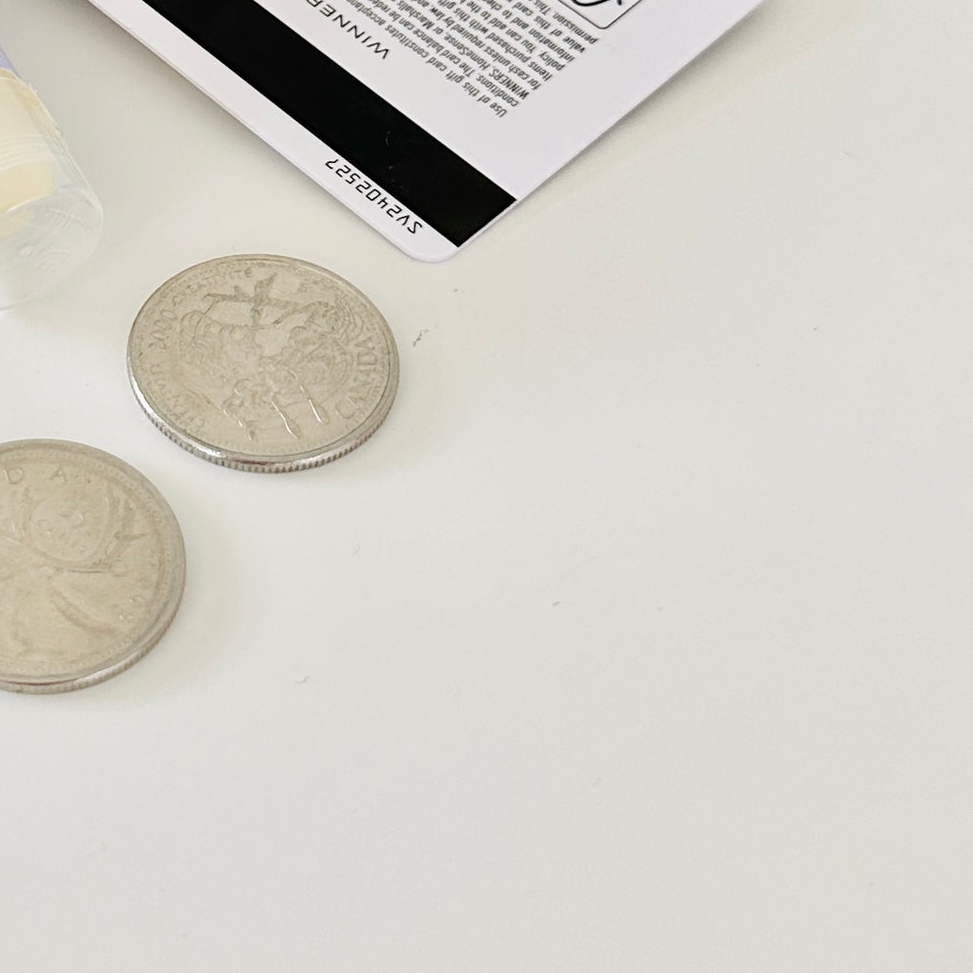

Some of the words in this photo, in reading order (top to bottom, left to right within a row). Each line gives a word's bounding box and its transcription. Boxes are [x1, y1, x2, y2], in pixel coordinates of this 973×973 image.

[451, 6, 471, 23] this
[465, 0, 482, 14] the
[478, 9, 492, 21] to
[500, 8, 513, 20] to
[510, 0, 535, 17] card
[387, 9, 402, 23] be
[397, 16, 416, 31] can
[441, 15, 456, 29] by
[486, 16, 508, 31] add
[508, 15, 530, 30] and
[532, 14, 552, 30] this
[431, 25, 444, 36] or
[467, 17, 490, 35] with
[503, 27, 523, 42] can
[547, 27, 564, 37] of
[383, 23, 430, 59] constitutes
[411, 27, 445, 54] balance
[448, 22, 486, 49] required
[483, 30, 532, 64] purchased
[519, 38, 537, 55] You
[527, 27, 576, 64] information
[561, 35, 586, 54] value
[424, 55, 448, 72] card
[437, 48, 462, 65] card
[481, 44, 512, 67] unless
[443, 69, 466, 84] gift
[457, 60, 476, 78] The
[506, 62, 531, 81] cash
[526, 60, 553, 82] Items
[460, 80, 481, 98] this
[525, 77, 542, 91] for
[475, 93, 492, 104] of
[488, 101, 508, 118] Use
[323, 157, 423, 234] SV2402527
